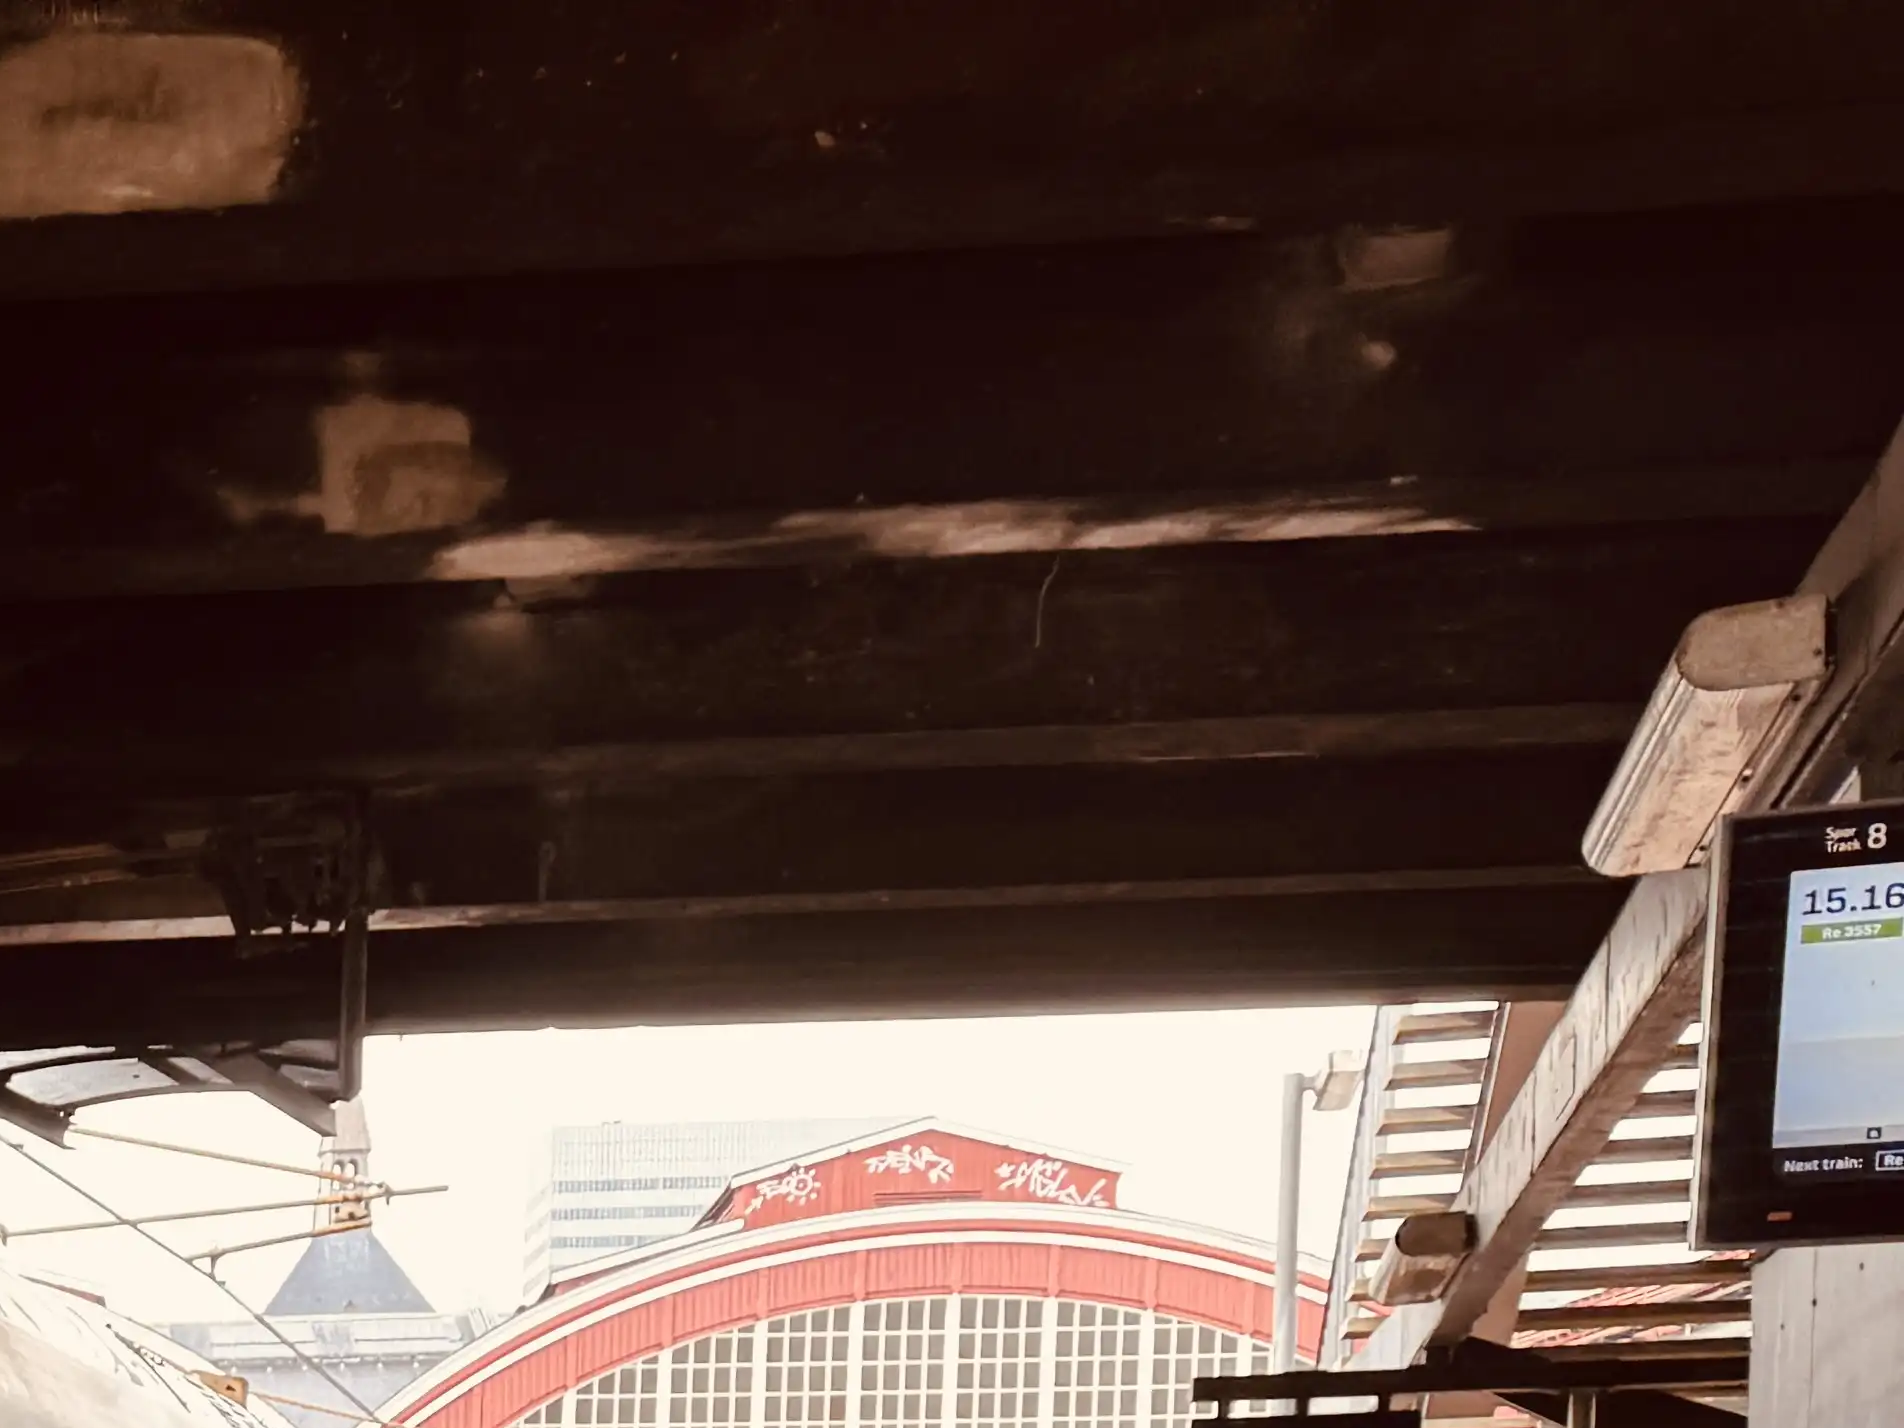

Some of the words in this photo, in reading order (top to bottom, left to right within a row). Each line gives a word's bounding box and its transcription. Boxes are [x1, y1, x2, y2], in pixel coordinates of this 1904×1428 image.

[1867, 822, 1887, 849] 8
[1802, 882, 1904, 915] 15.16
[1822, 927, 1841, 940] Re
[1784, 1159, 1820, 1172] Next
[1822, 1156, 1863, 1171] train:
[1884, 1153, 1904, 1166] Re
